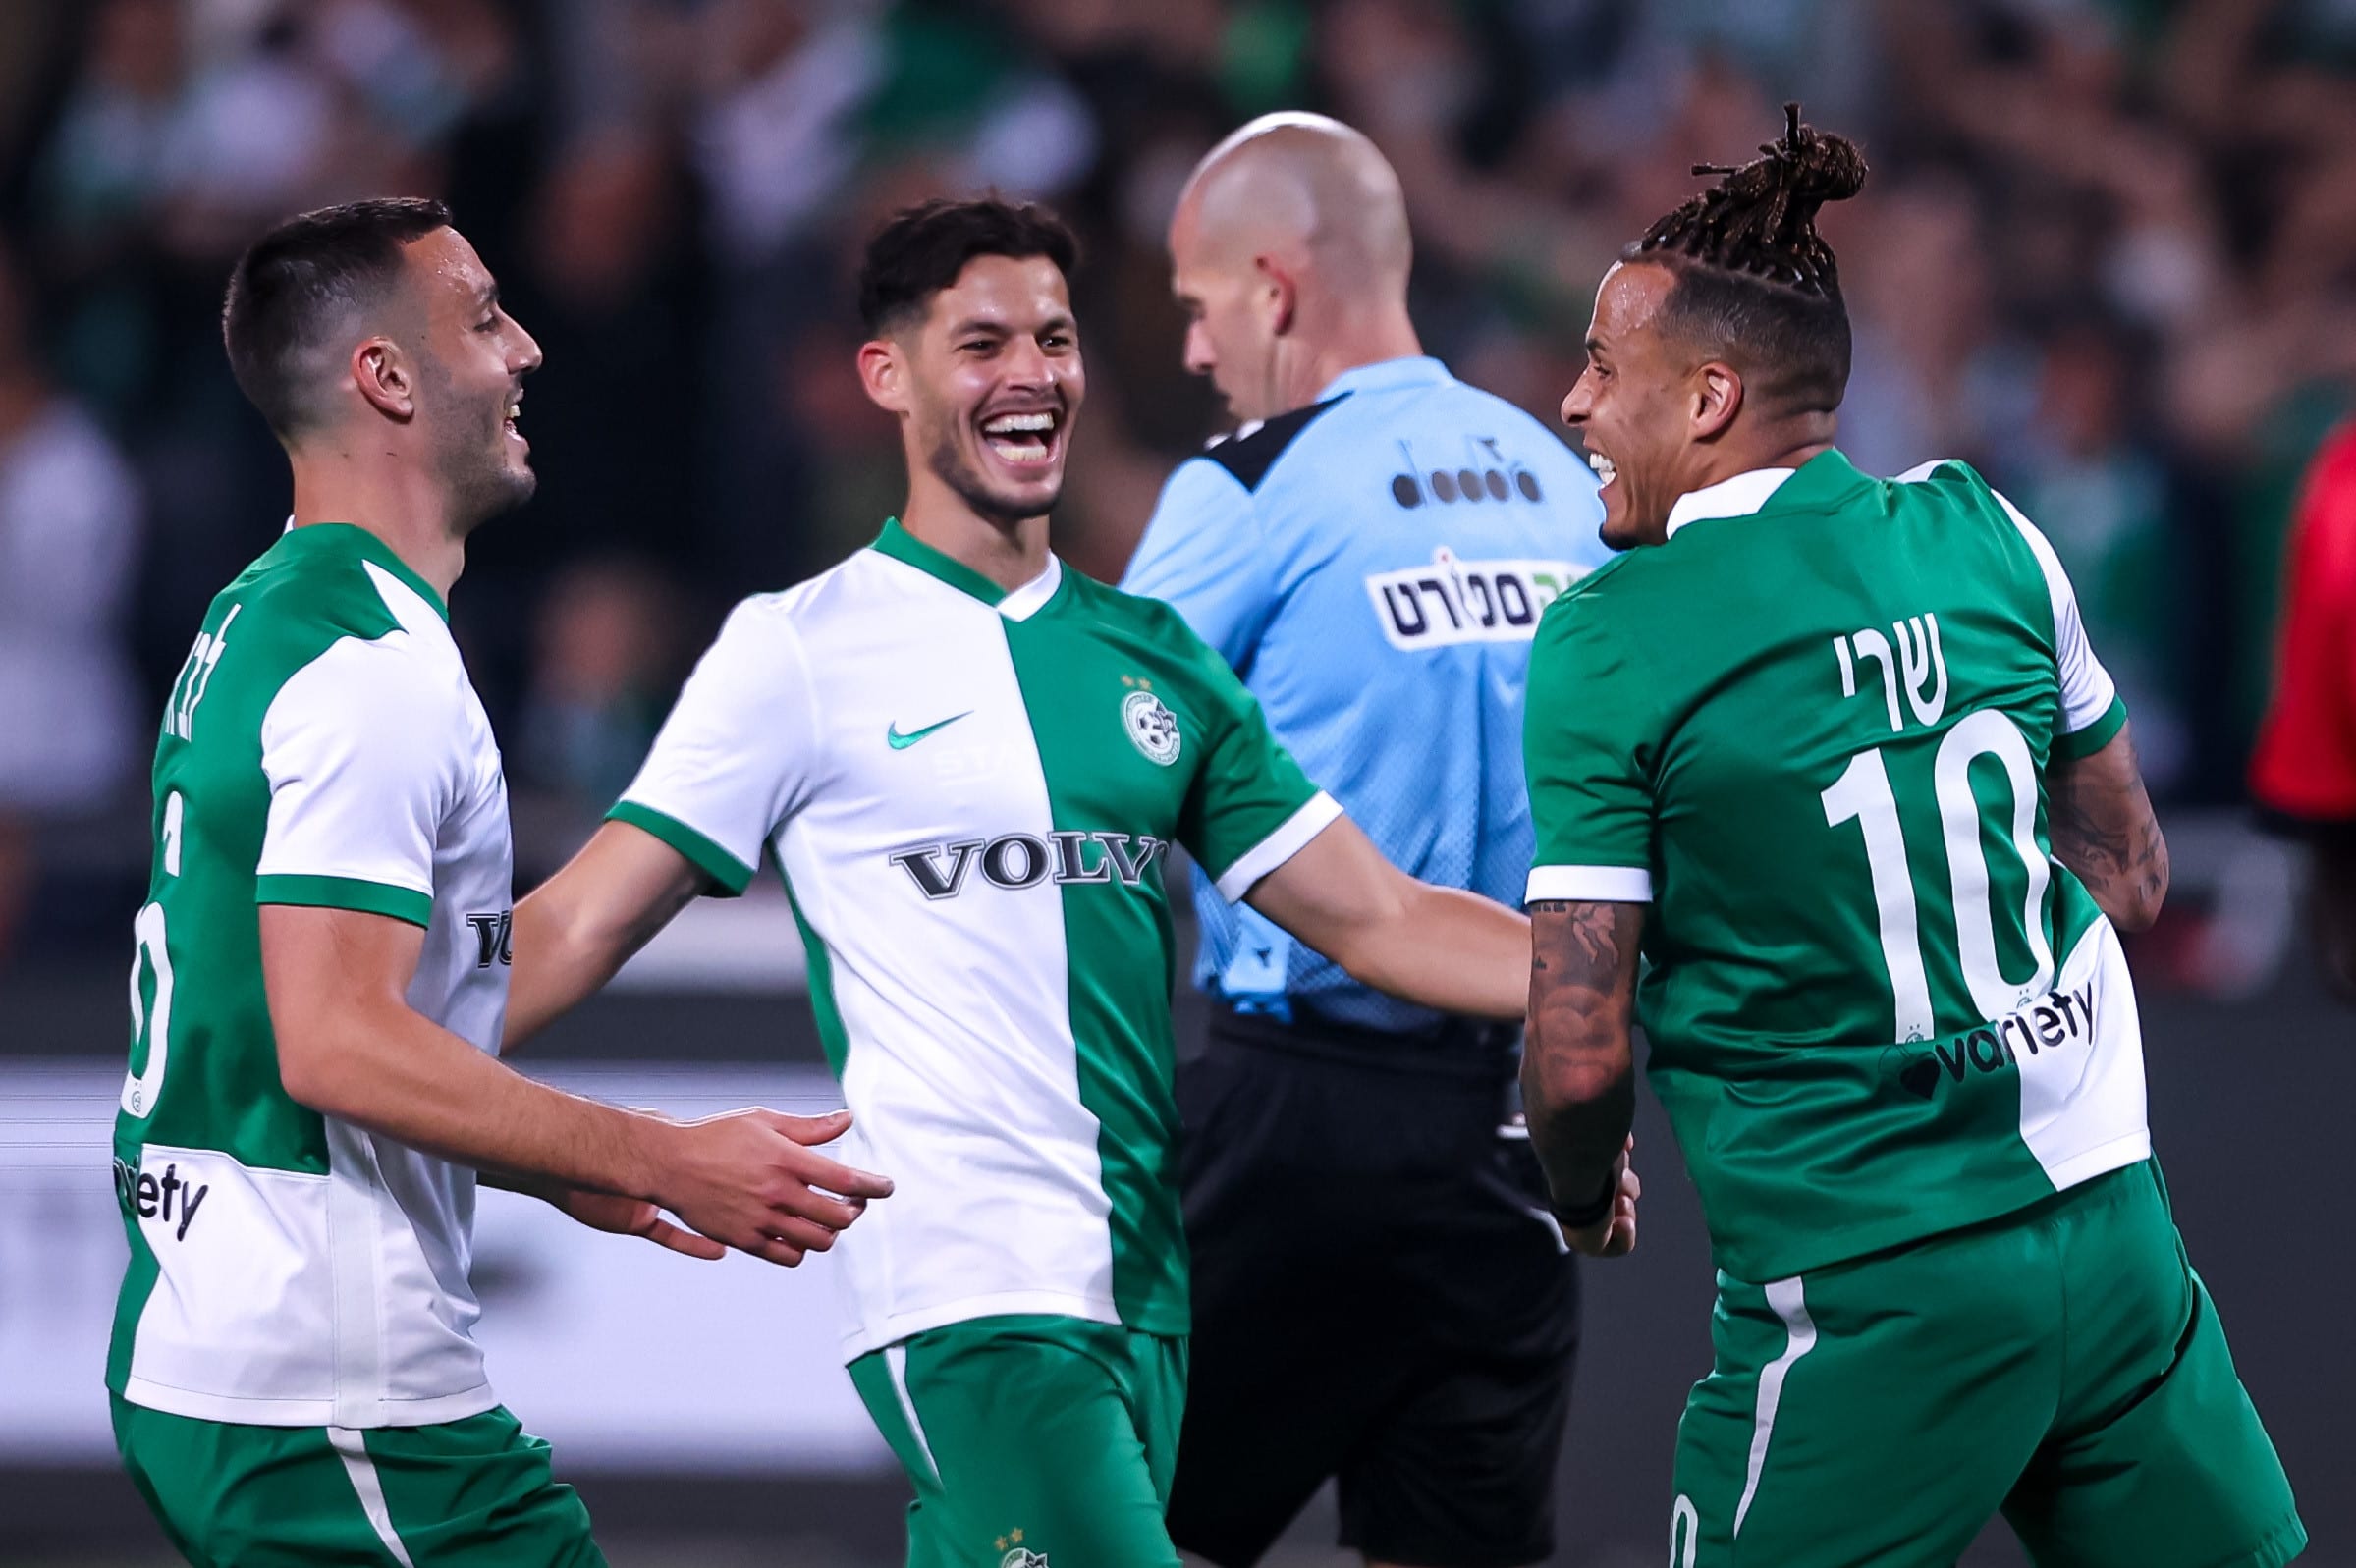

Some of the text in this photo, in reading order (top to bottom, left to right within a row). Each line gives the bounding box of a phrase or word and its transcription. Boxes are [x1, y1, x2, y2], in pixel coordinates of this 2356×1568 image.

[1833, 612, 1948, 732] שרי
[889, 831, 1170, 900] VOLV
[1820, 708, 2056, 1045] 10
[1934, 980, 2095, 1083] variety
